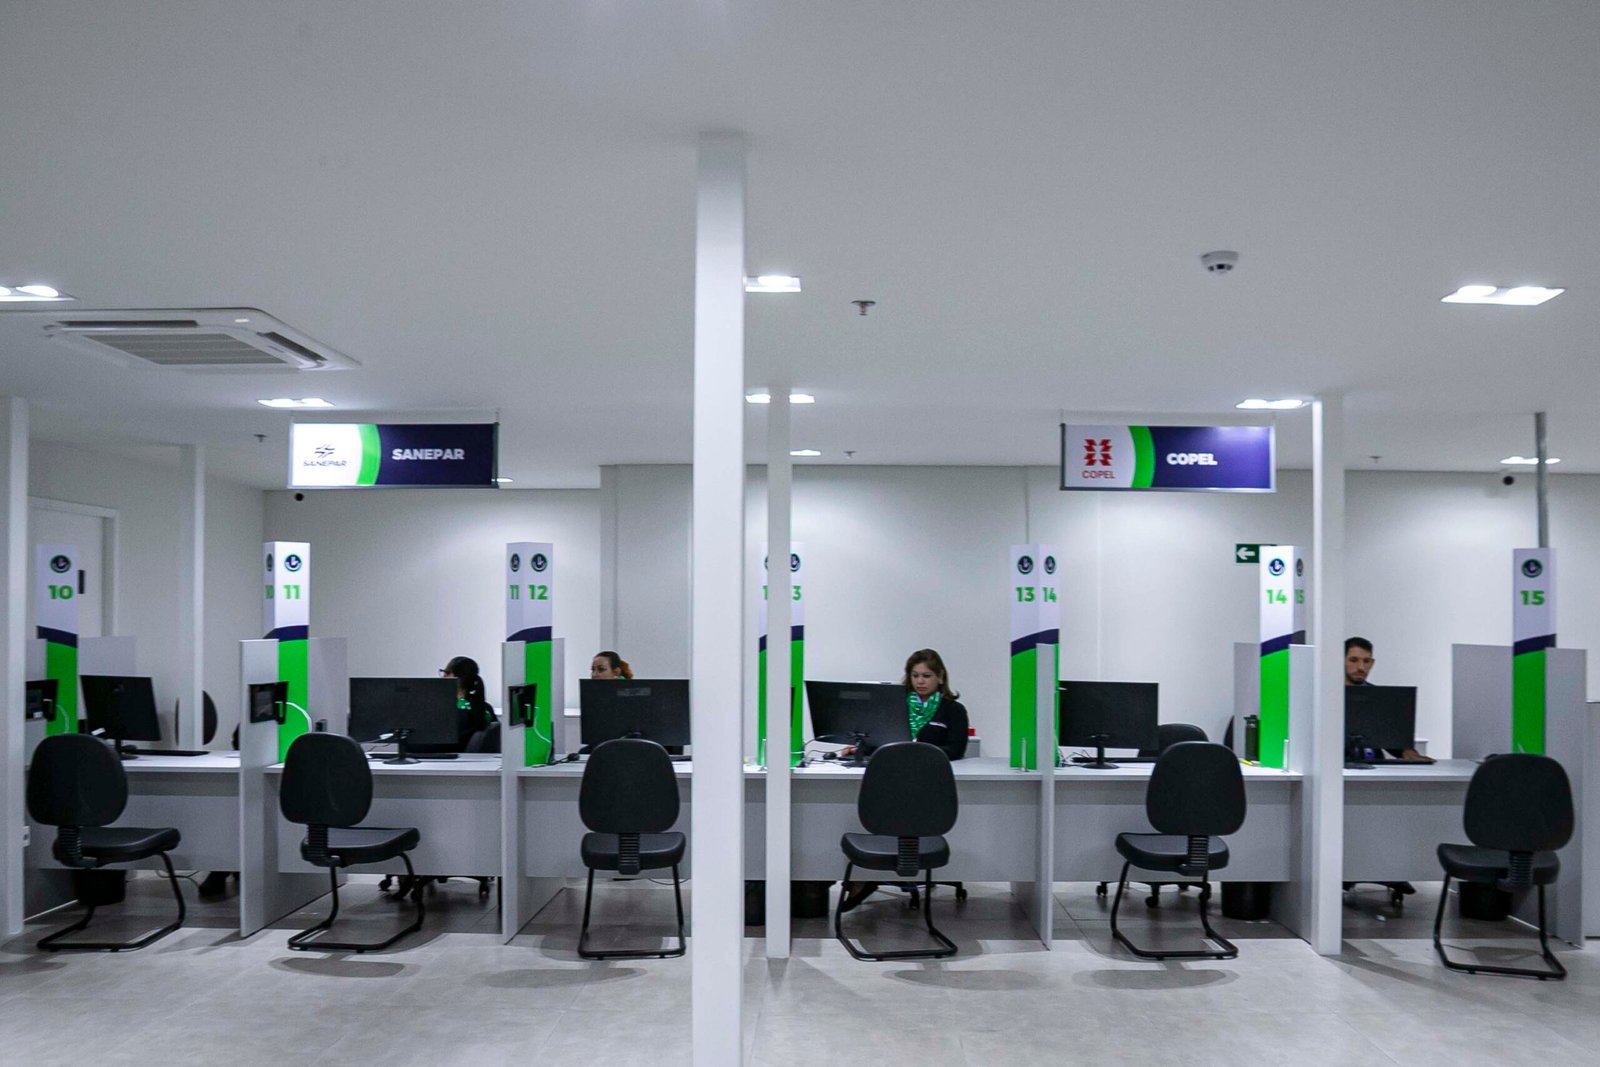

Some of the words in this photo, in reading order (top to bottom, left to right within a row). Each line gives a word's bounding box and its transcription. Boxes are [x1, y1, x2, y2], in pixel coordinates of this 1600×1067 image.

[391, 448, 466, 461] SANEPAR
[1166, 453, 1218, 465] COPEL
[1081, 470, 1116, 479] COPEL
[48, 585, 74, 600] 10
[283, 585, 300, 600] 11
[509, 585, 520, 600] 11
[528, 585, 549, 600] 12
[1015, 587, 1035, 602] 13
[1042, 587, 1057, 602] 14
[1266, 589, 1288, 604] 14
[1520, 590, 1546, 606] 15
